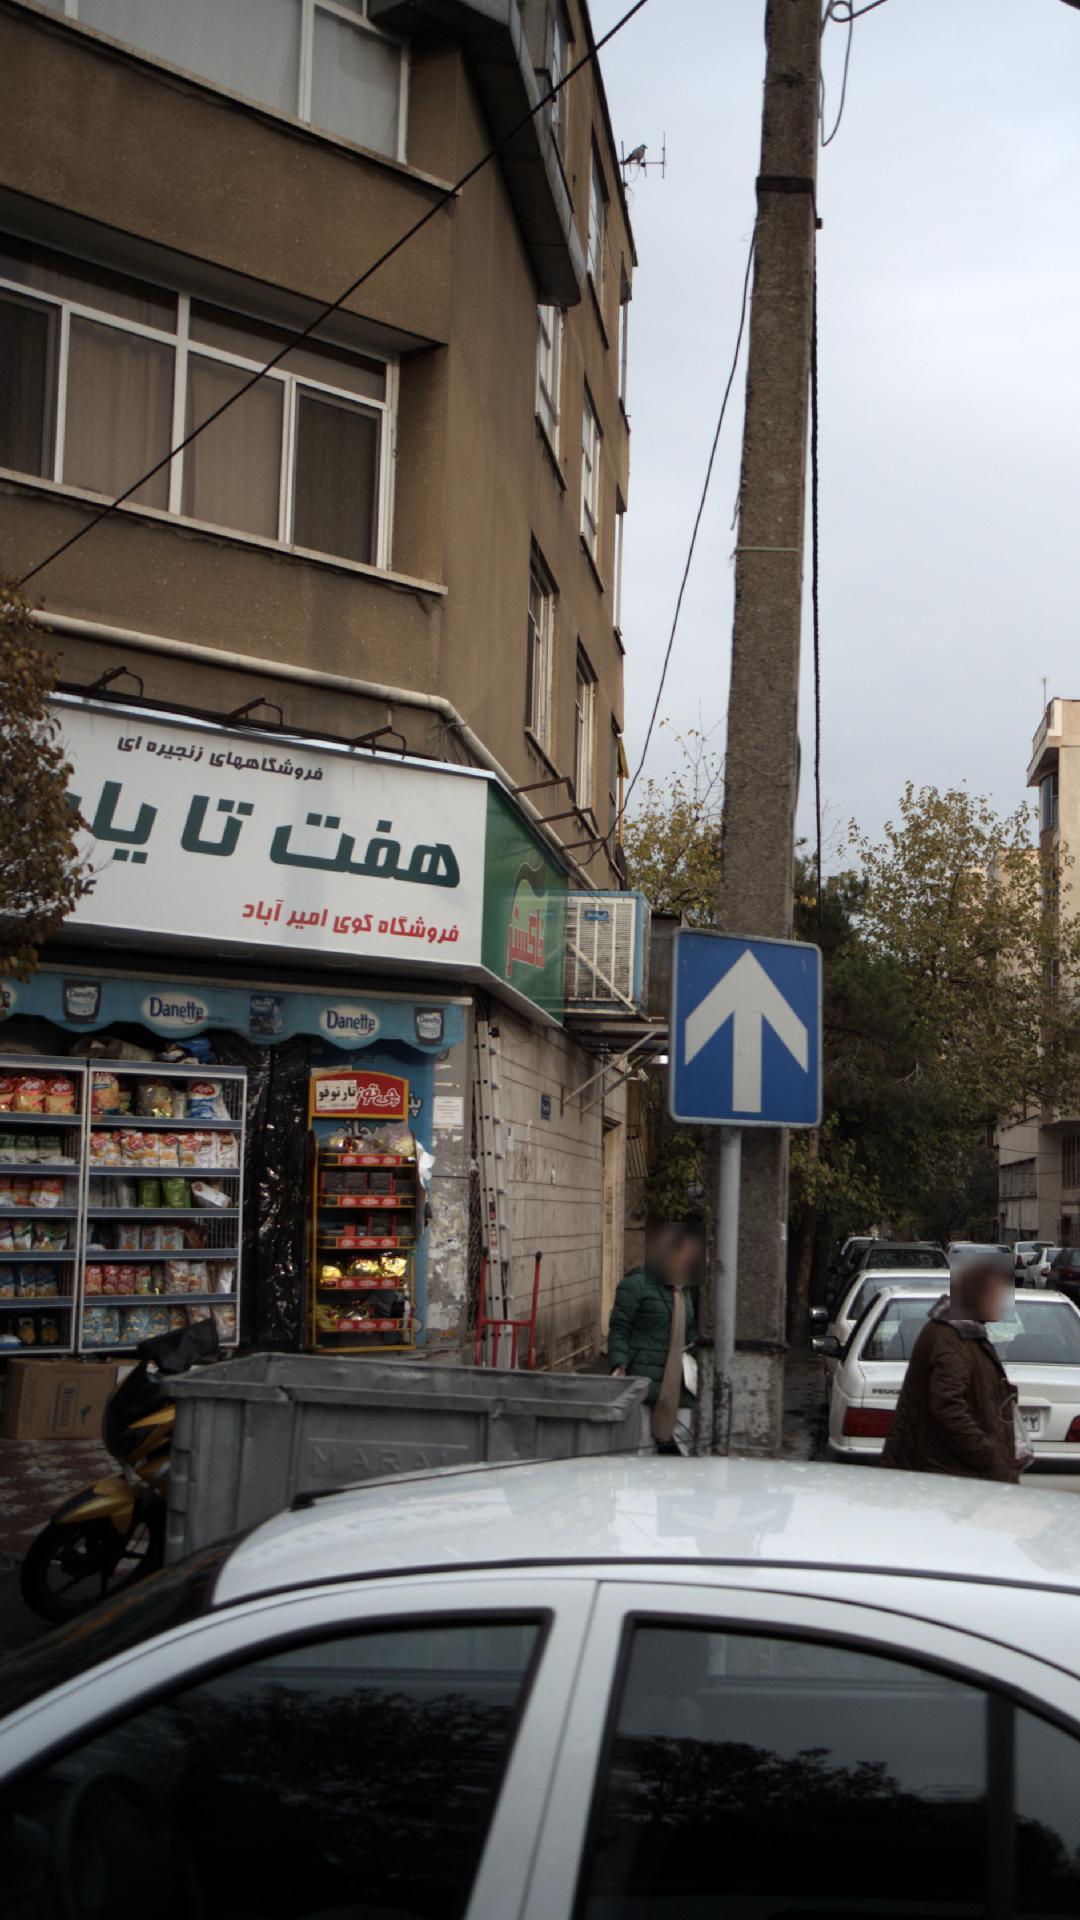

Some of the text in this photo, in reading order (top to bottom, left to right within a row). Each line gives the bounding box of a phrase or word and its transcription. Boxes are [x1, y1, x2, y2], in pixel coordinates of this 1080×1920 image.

[117, 735, 324, 781] فروشگاههای زنجیره ای
[64, 780, 461, 889] هفت تا یا
[241, 898, 460, 944] فروشگاه کوی امیر آباد
[149, 996, 204, 1019] Danette
[326, 1010, 376, 1030] Danette
